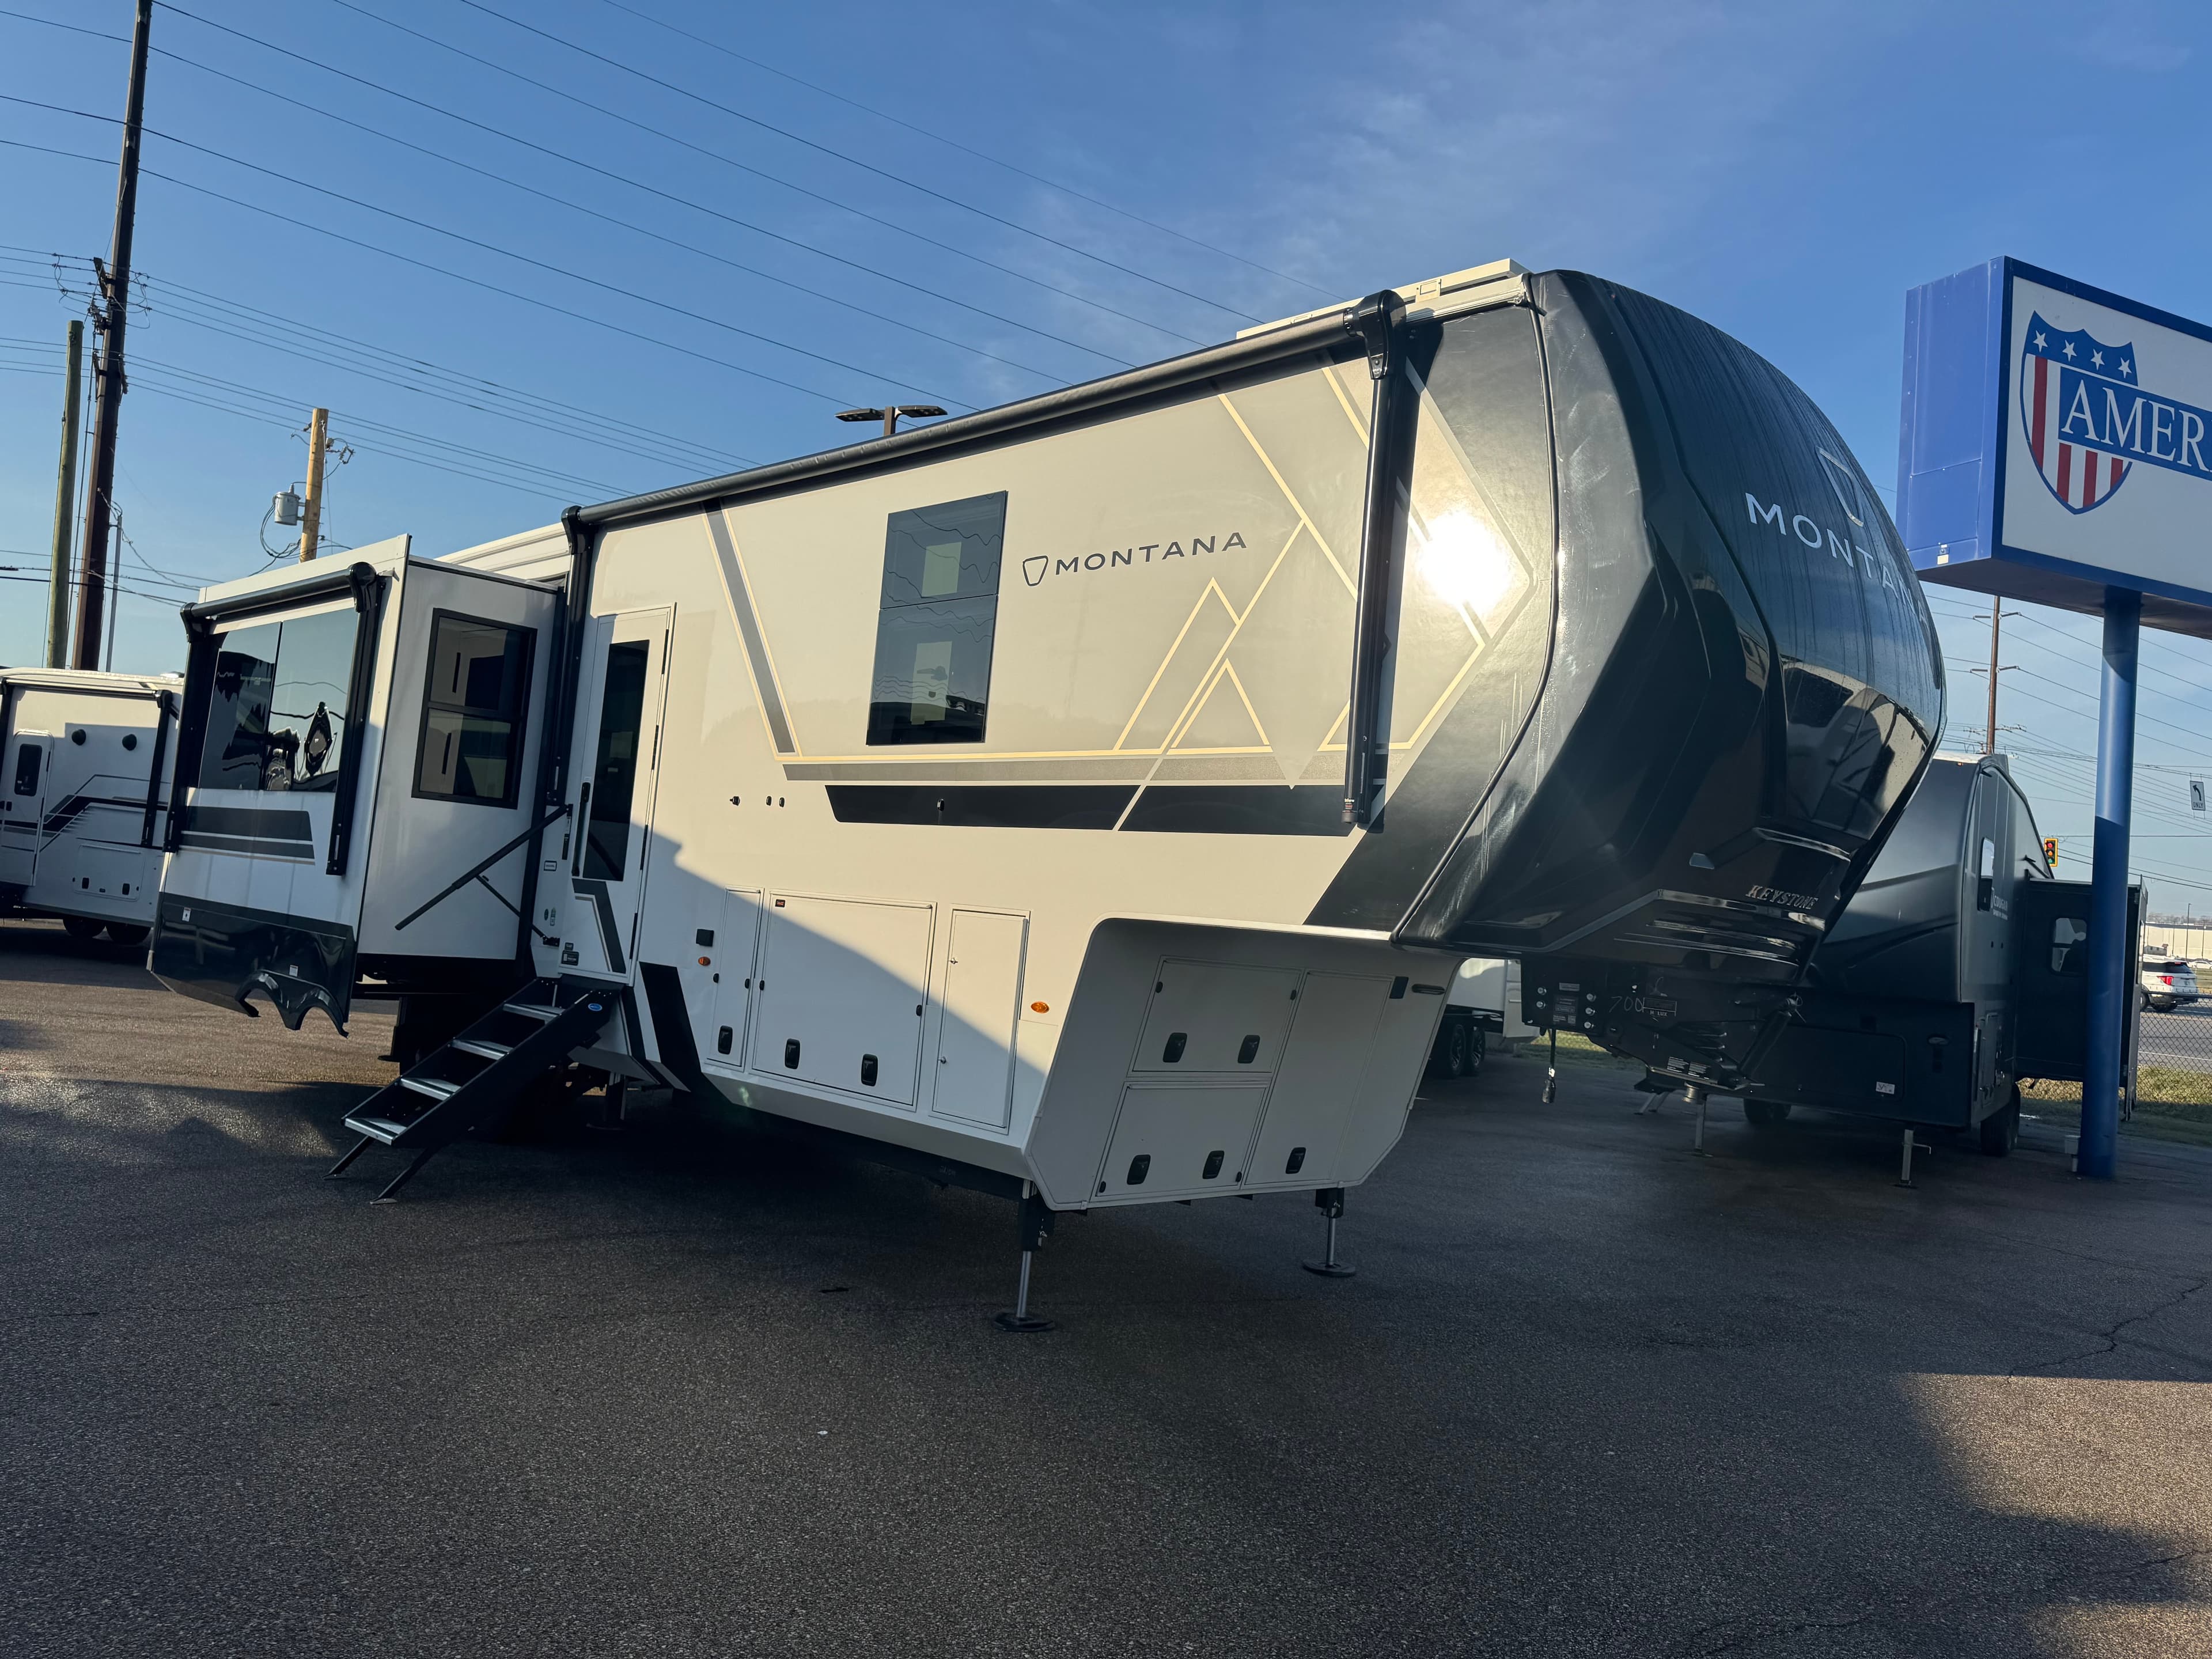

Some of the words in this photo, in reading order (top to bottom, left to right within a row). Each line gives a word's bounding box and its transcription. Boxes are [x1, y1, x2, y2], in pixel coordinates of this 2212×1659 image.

[2061, 379, 2212, 473] AMER
[1055, 532, 1247, 575] MONTANA
[1745, 493, 1930, 634] MONTANA
[1745, 885, 1819, 910] KEYSTONE
